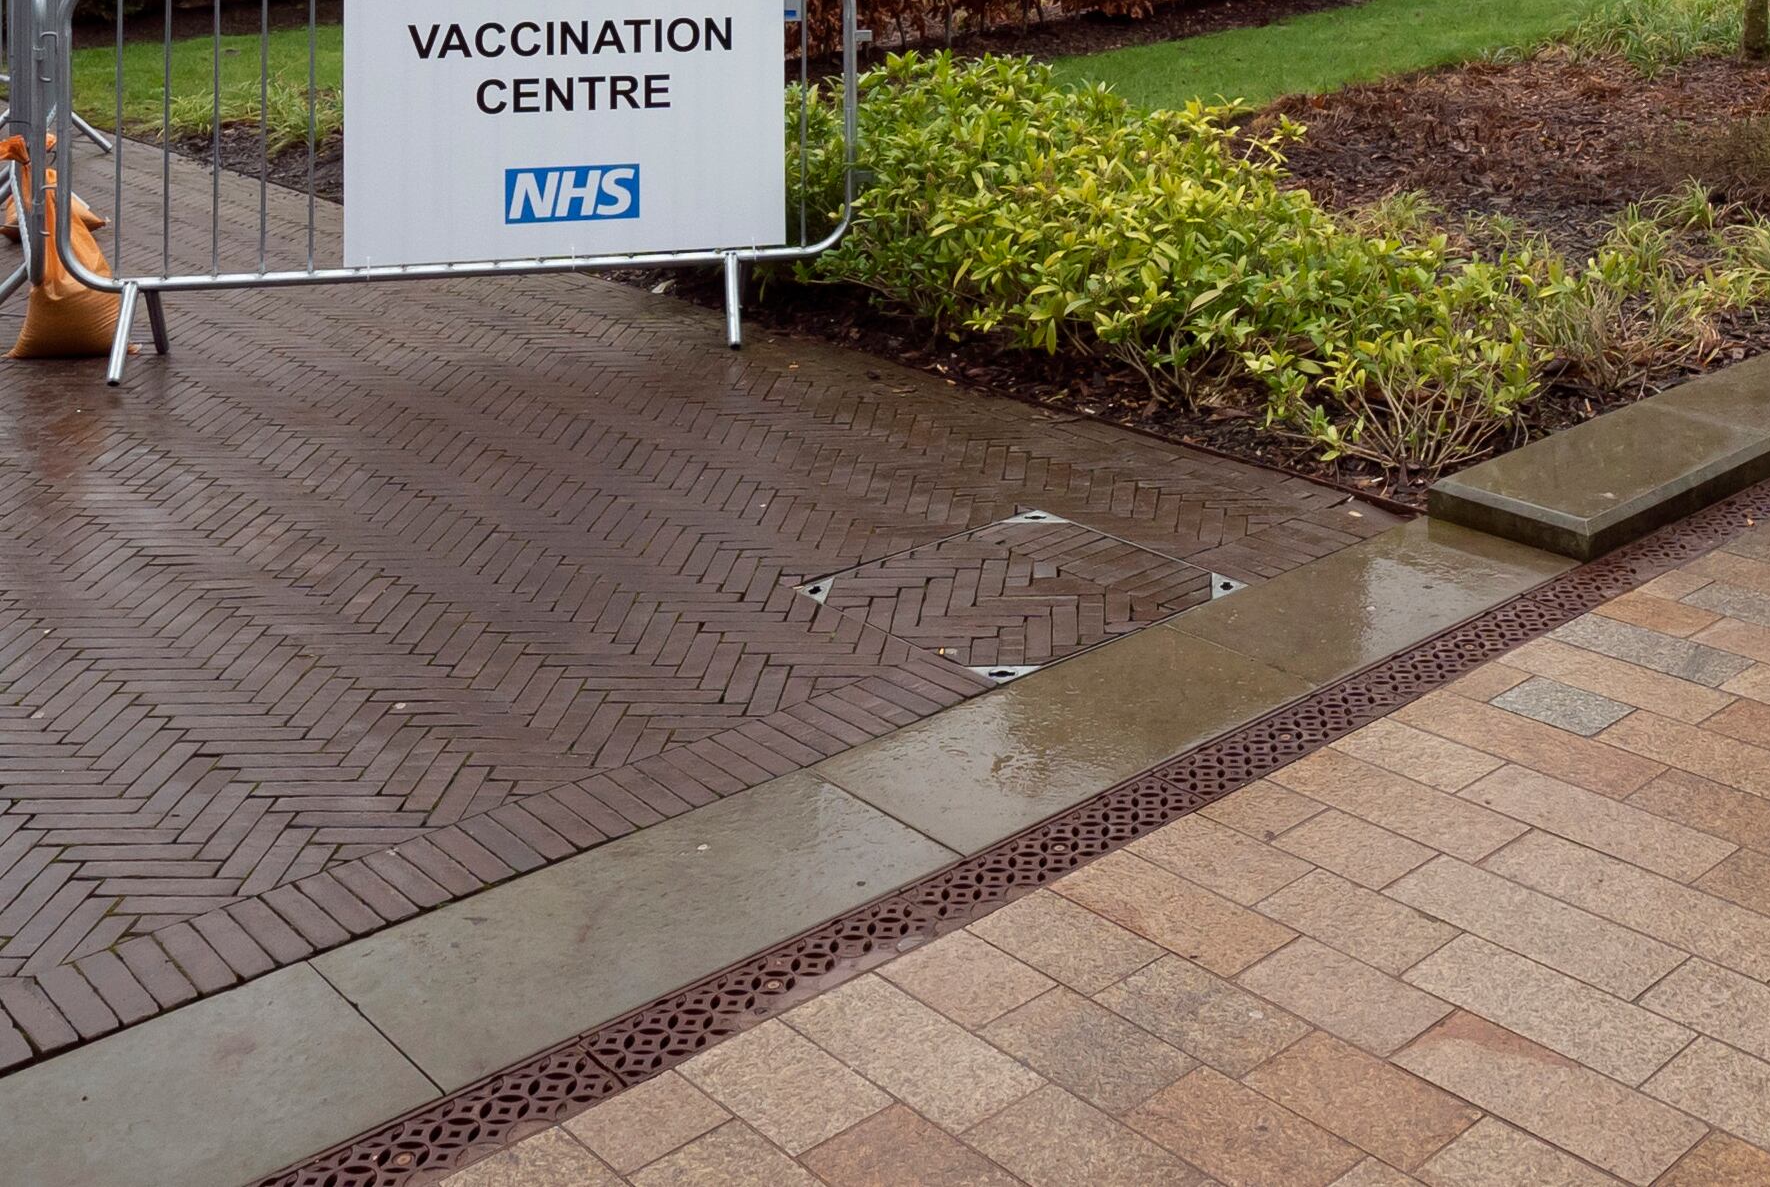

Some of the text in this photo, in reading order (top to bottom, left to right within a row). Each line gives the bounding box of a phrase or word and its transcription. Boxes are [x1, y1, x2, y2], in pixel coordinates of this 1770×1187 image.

[408, 17, 733, 59] VACCINATION
[476, 74, 671, 114] CENTRE
[508, 167, 635, 220] NHS
